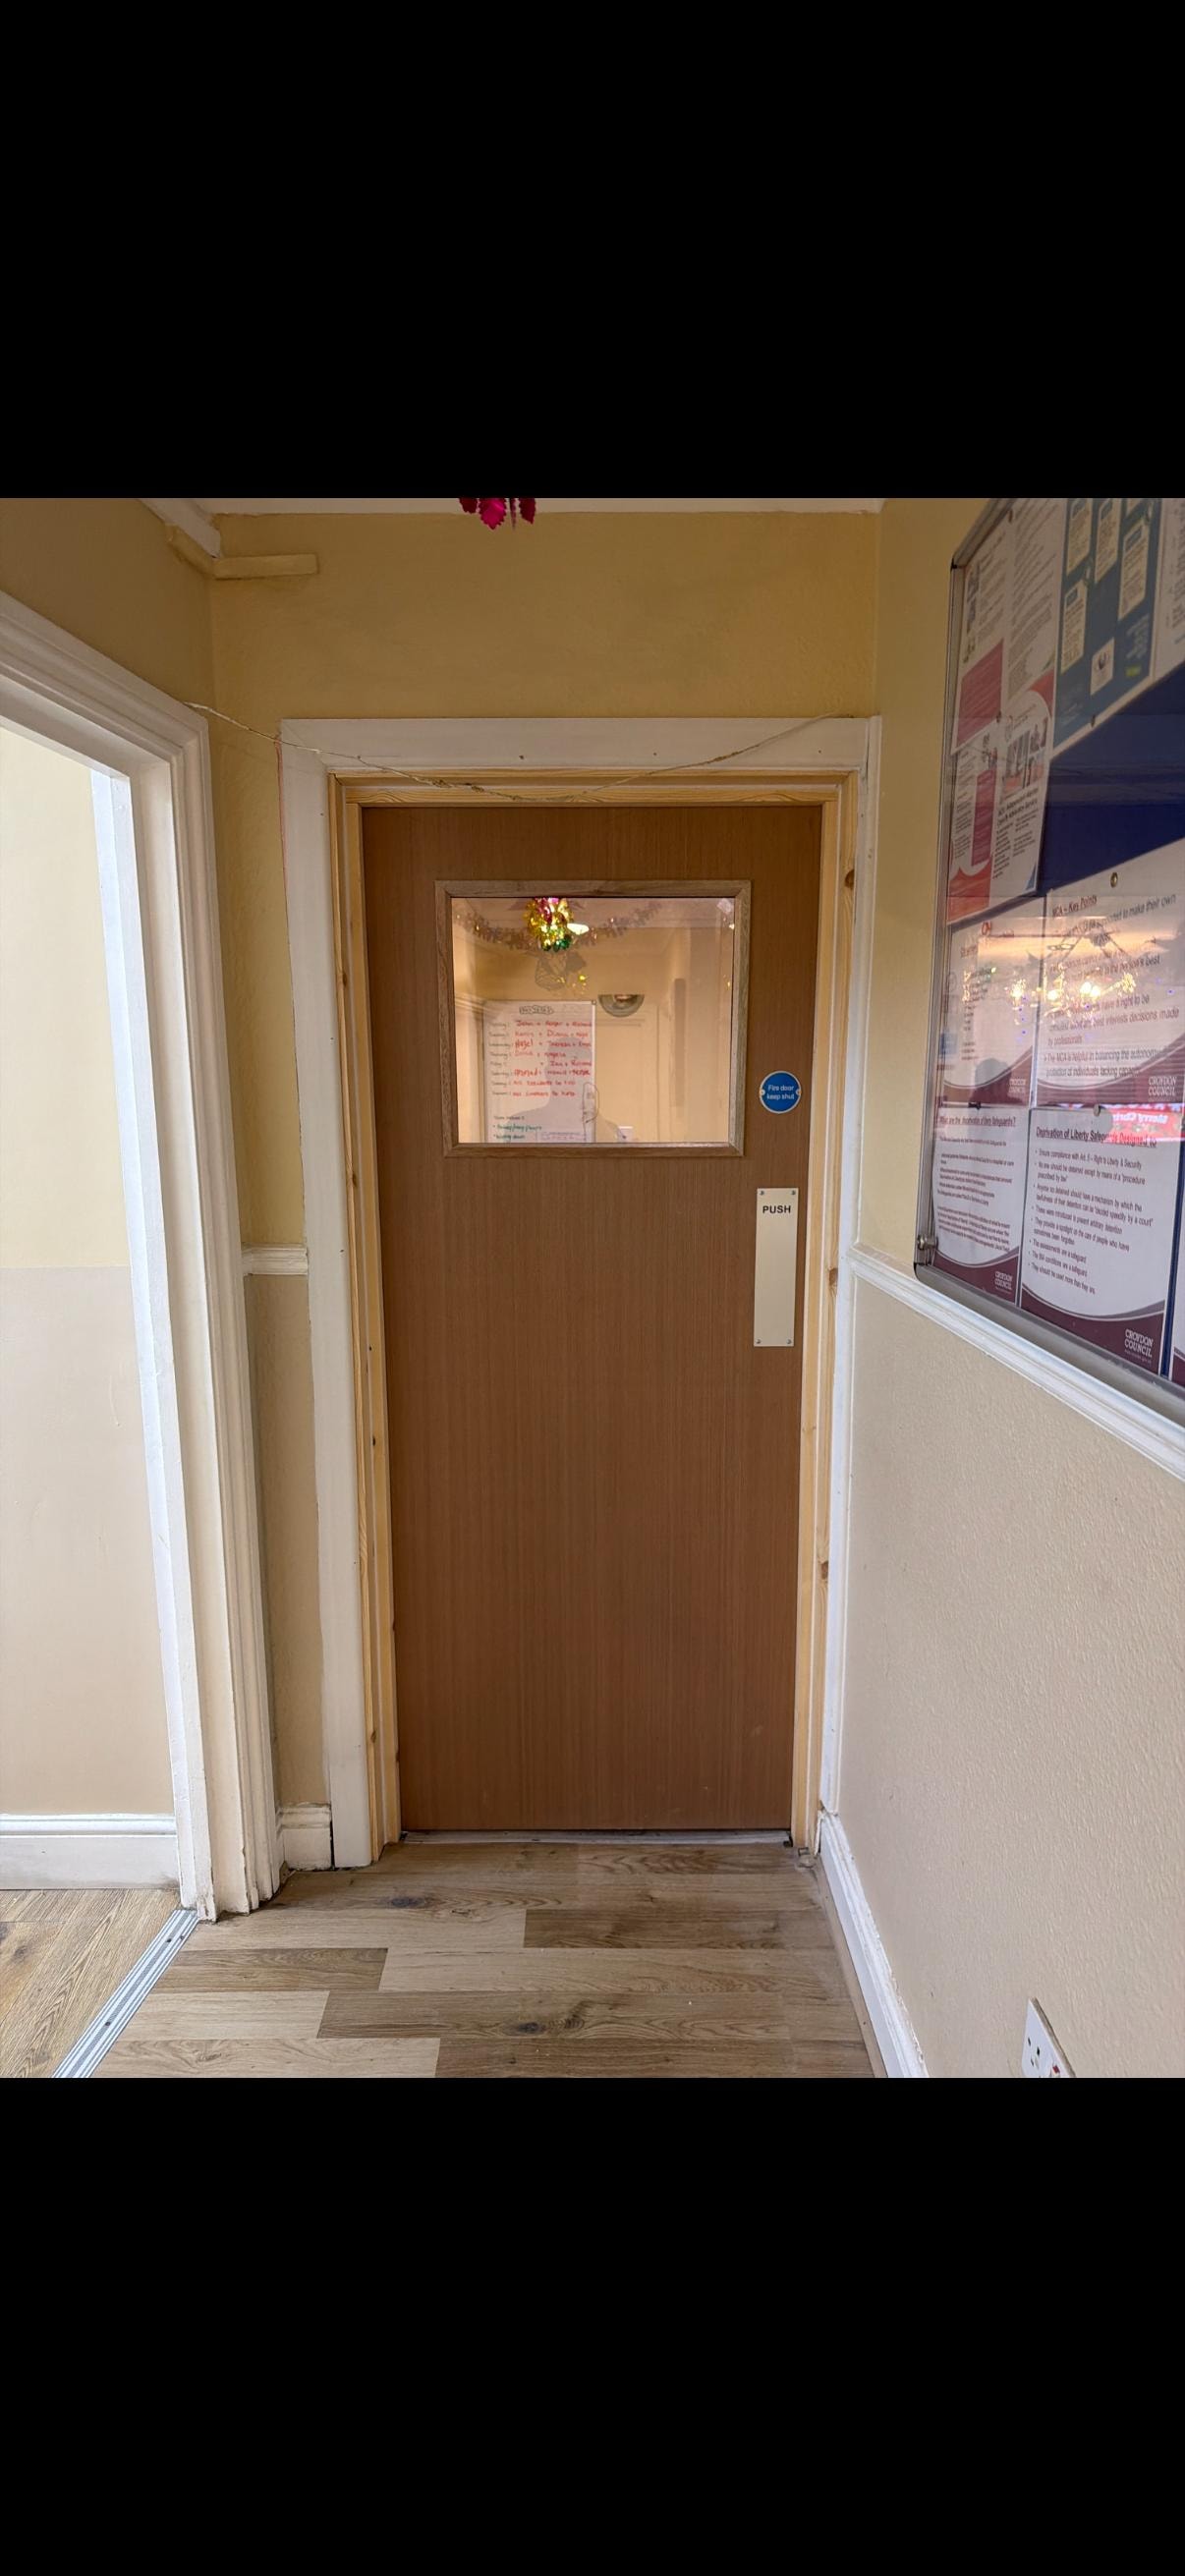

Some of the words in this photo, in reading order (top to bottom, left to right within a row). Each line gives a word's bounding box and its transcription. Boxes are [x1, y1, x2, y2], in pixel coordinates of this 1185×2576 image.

[1069, 902, 1079, 913] Key
[1081, 895, 1097, 910] Points
[1129, 903, 1145, 915] make
[1146, 896, 1159, 911] their
[1161, 894, 1176, 907] own
[1146, 954, 1160, 966] best
[1121, 995, 1133, 1009] right
[1135, 995, 1140, 1005] to
[1142, 993, 1149, 1003] be
[1129, 1010, 1157, 1022] decisions
[1161, 1008, 1179, 1019] made
[1057, 1052, 1067, 1061] MCA
[1148, 1076, 1177, 1085] CROYDON
[1148, 1086, 1176, 1096] COUNCIL
[1037, 1126, 1063, 1139] Deprivation
[1064, 1128, 1070, 1138] of
[1071, 1129, 1090, 1142] Liberty
[1120, 1132, 1148, 1147] Designed
[1149, 1136, 1157, 1147] to
[1094, 1155, 1102, 1165] Right
[1108, 1157, 1119, 1167] Liberty
[1124, 1159, 1141, 1171] Security
[1071, 1190, 1082, 1198] should
[1094, 1196, 1114, 1206] mechanism
[1114, 1199, 1119, 1208] by
[1120, 1201, 1133, 1210] which
[762, 1205, 791, 1214] PUSH
[1110, 1211, 1126, 1223] speedily
[1128, 1214, 1133, 1224] by
[1109, 1240, 1117, 1248] who
[1039, 1266, 1051, 1275] should
[1125, 1329, 1154, 1346] CROYDON
[1125, 1339, 1152, 1358] COUNCIL
